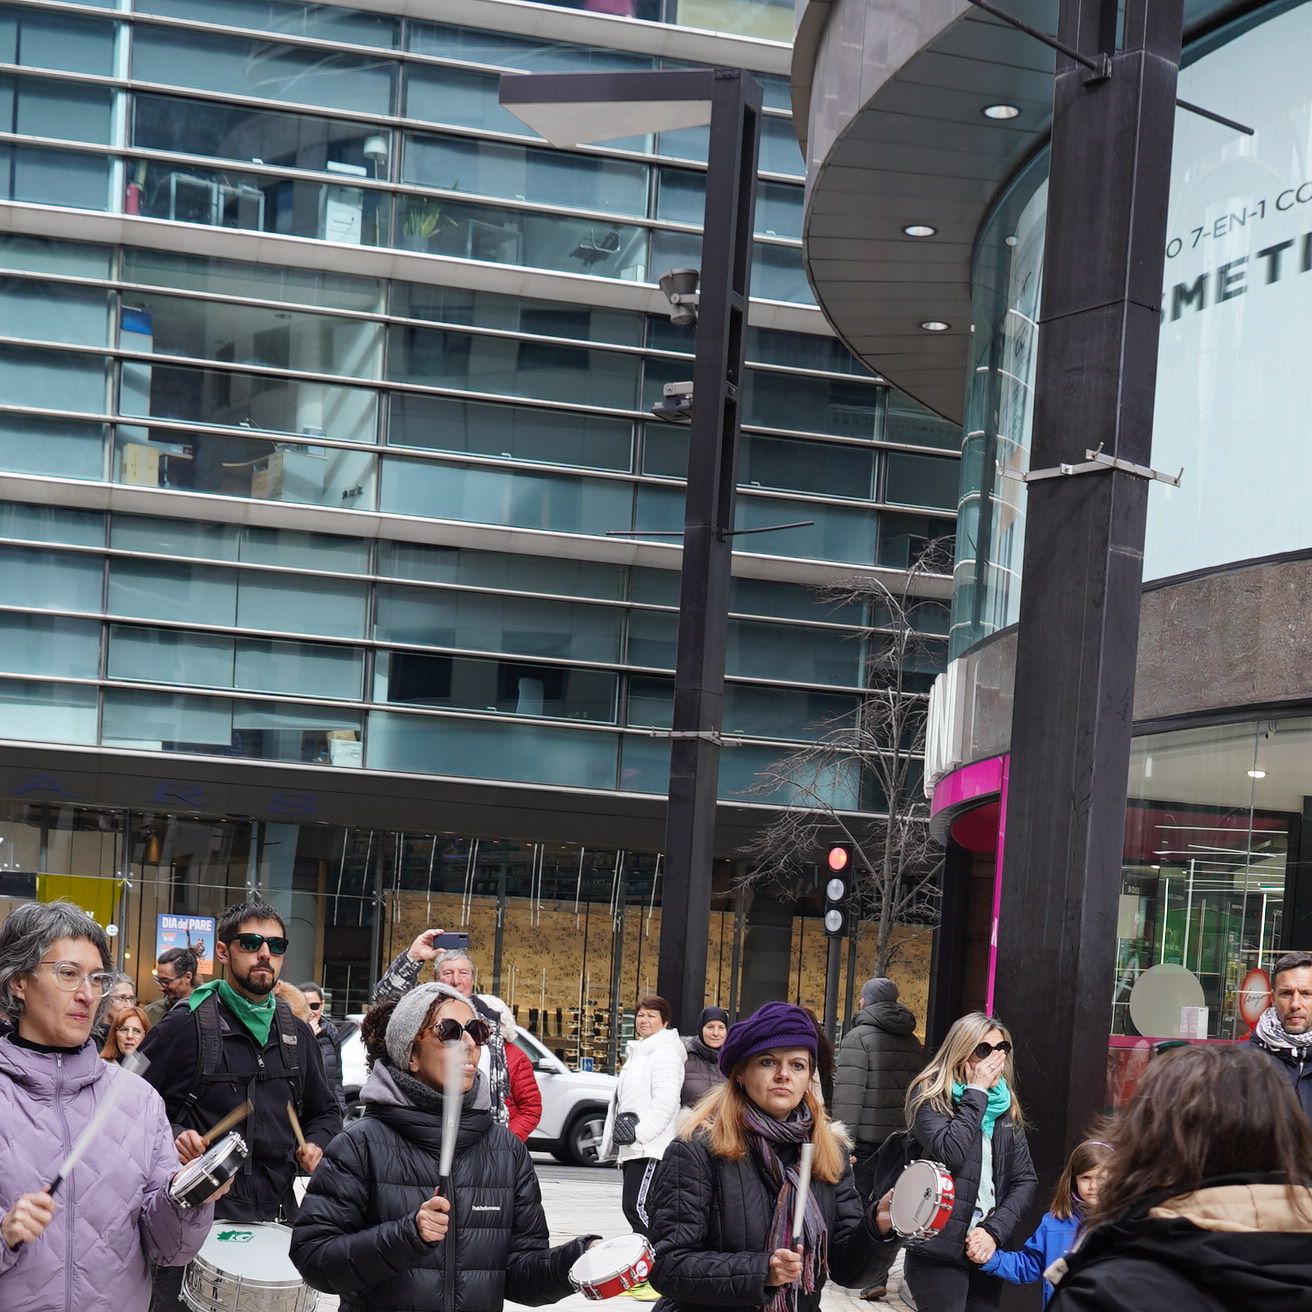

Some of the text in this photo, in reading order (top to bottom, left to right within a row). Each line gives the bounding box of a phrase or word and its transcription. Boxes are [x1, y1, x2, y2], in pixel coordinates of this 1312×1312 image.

[1191, 200, 1267, 250] 7-EN-1
[162, 917, 177, 929] DIA
[189, 918, 212, 931] PARE
